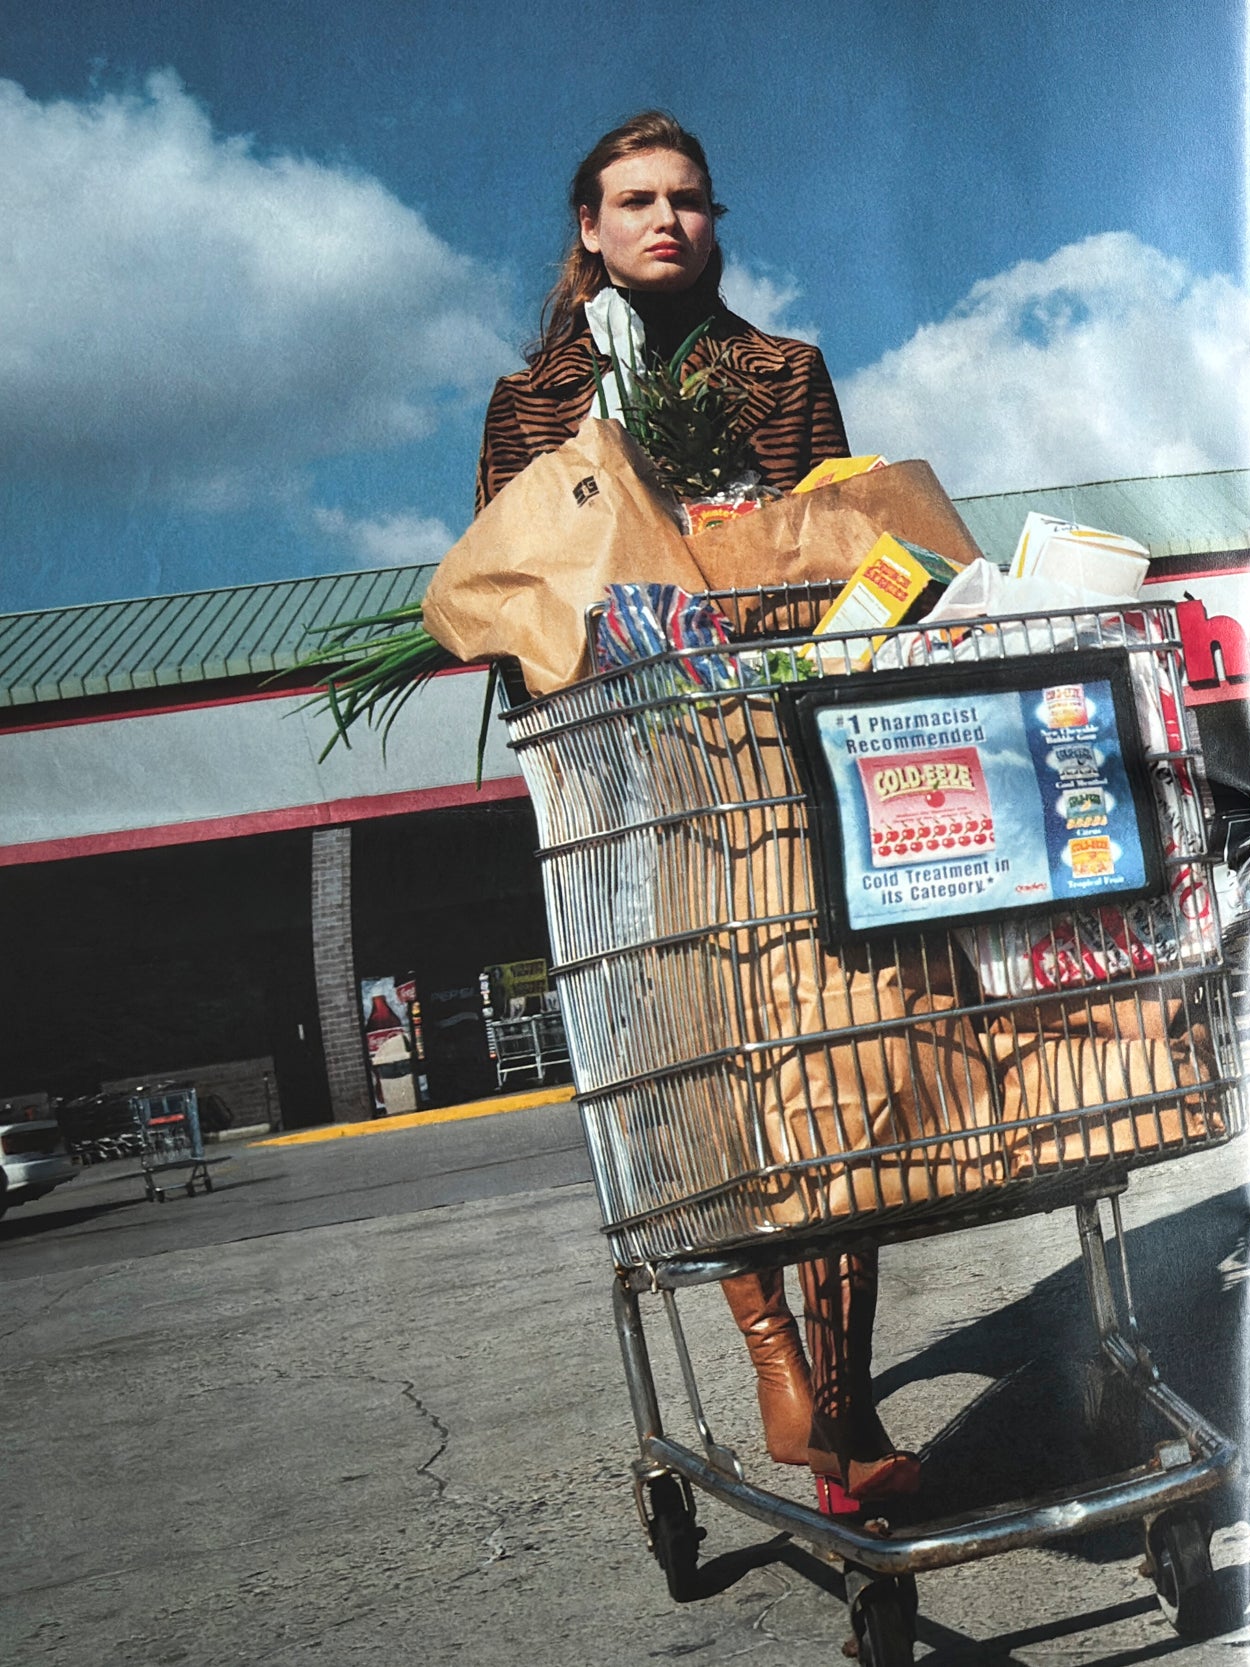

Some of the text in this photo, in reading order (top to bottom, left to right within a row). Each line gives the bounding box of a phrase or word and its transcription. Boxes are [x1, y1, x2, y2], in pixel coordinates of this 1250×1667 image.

[836, 707, 978, 735] #1 Pharmacist
[846, 726, 985, 754] Recommended
[874, 763, 975, 796] COLD-EEZE
[863, 857, 1010, 891] Cold Treatment in
[881, 889, 903, 905] its
